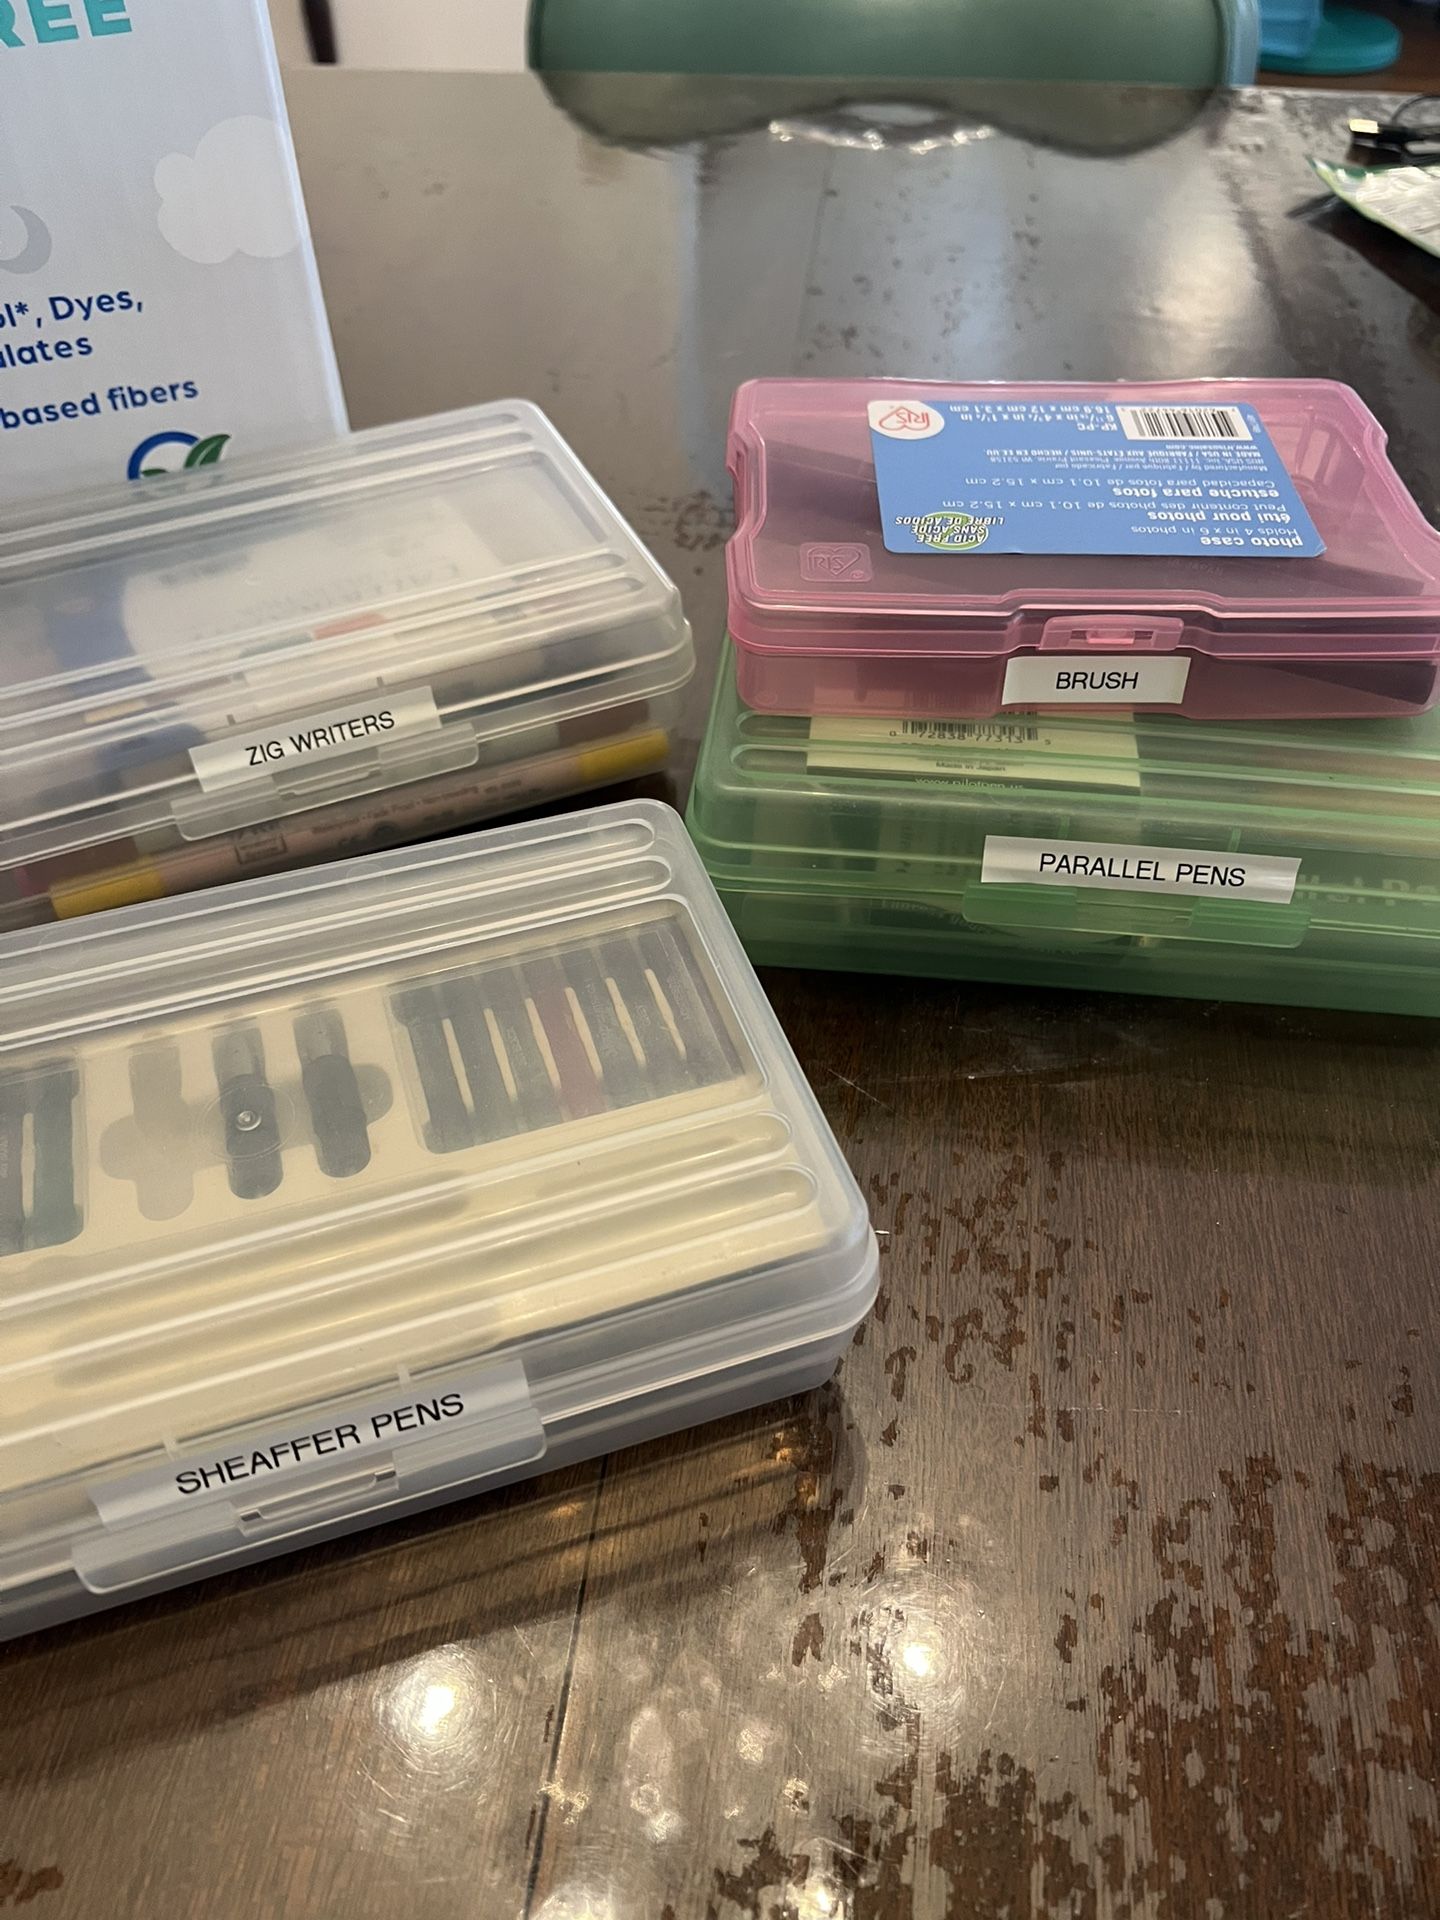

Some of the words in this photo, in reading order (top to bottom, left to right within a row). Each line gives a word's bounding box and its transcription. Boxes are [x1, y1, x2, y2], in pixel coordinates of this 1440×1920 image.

[0, 302, 42, 328] l,
[49, 290, 143, 321] Dyes,
[0, 392, 101, 429] based
[107, 380, 198, 411] fibers
[1202, 450, 1220, 458] USA
[1222, 450, 1233, 458] IN
[1236, 450, 1262, 458] MADE
[992, 478, 1024, 486] 15.2
[1071, 478, 1101, 486] 10.1
[1107, 479, 1124, 487] de
[1128, 479, 1163, 488] fotos
[1168, 477, 1197, 486] para
[1202, 478, 1275, 489] Capacidad
[1112, 487, 1158, 498] fotos
[1163, 486, 1202, 497] para
[1209, 489, 1280, 499] estuche
[970, 500, 1002, 509] 15.2
[1049, 501, 1081, 509] 10.1
[1088, 501, 1104, 509] de
[1109, 500, 1156, 510] photos
[1161, 502, 1185, 511] des
[1191, 503, 1249, 511] contenir
[1254, 503, 1287, 512] Peut
[947, 516, 963, 525] DE
[967, 516, 1004, 525] LIBRE
[1147, 511, 1206, 523] photos
[1212, 510, 1250, 522] pour
[1257, 513, 1291, 525] étui
[911, 525, 949, 534] ACIDE
[952, 525, 986, 534] SANS
[1131, 524, 1177, 534] photos
[1181, 527, 1193, 535] in
[1200, 527, 1210, 535] 6
[1226, 528, 1239, 536] in
[1245, 528, 1253, 536] 4
[1257, 528, 1298, 537] Holds
[916, 533, 949, 543] FREE
[954, 533, 986, 543] ACID
[1200, 536, 1244, 546] case
[1250, 535, 1303, 548] photo
[1055, 671, 1139, 690] BRUSH
[245, 740, 285, 766] ZIG
[289, 710, 395, 752] WRITERS
[1039, 853, 1166, 882] PARALLEL
[1175, 863, 1246, 887] PENS
[175, 1423, 361, 1494] SHEAFFER
[371, 1393, 464, 1439] PENS
